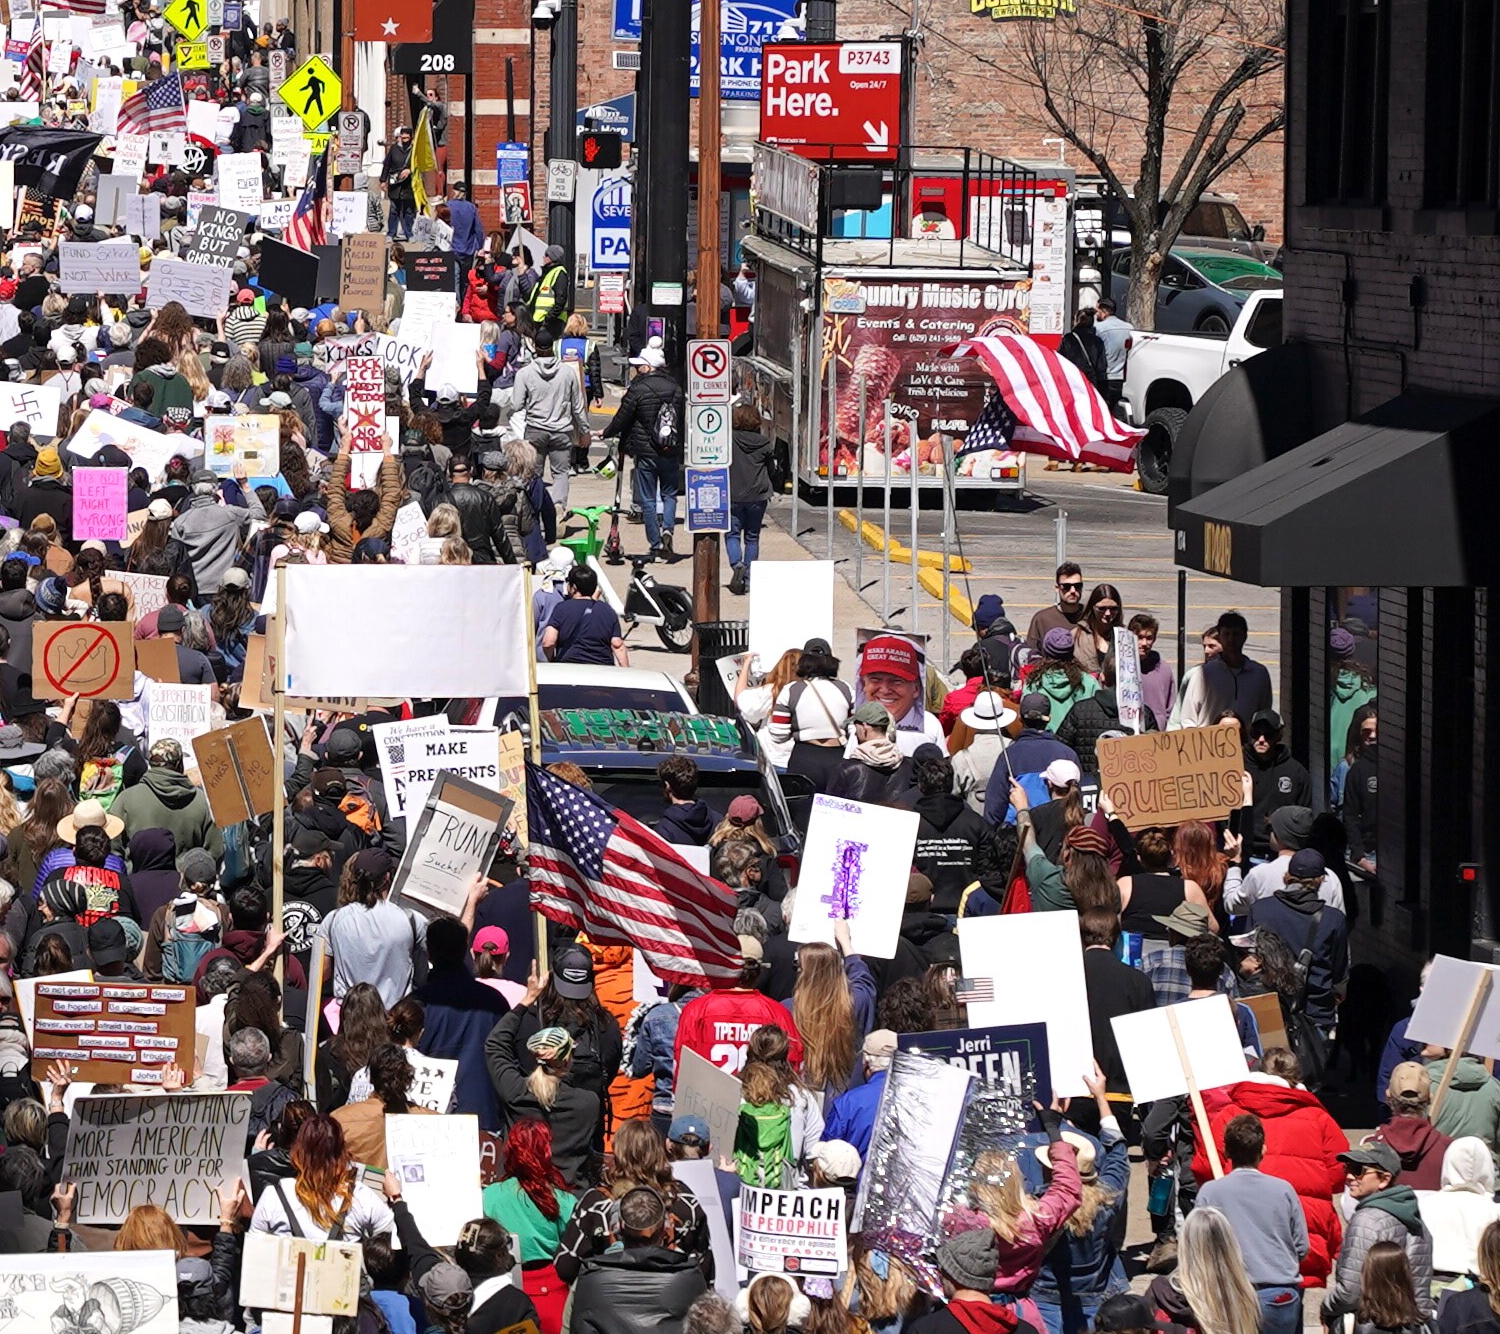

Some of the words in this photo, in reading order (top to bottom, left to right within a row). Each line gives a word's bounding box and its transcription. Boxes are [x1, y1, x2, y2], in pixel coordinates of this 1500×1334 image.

[419, 55, 455, 73] 208
[848, 51, 889, 65] P3743
[768, 53, 830, 83] Park
[850, 81, 868, 91] Open
[869, 81, 887, 89] 24/7
[767, 87, 839, 116] Here.
[215, 210, 237, 224] NO
[197, 223, 240, 241] KINGS
[203, 237, 231, 254] BUT
[187, 251, 233, 268] CHRIST
[922, 283, 981, 309] Music
[857, 318, 900, 329] Events
[905, 320, 914, 329] &
[920, 320, 975, 333] Catering
[1176, 726, 1236, 759] KINGS
[1105, 771, 1242, 811] QUEENS
[74, 1131, 123, 1157] MORE
[133, 1128, 224, 1157] AMERICAN
